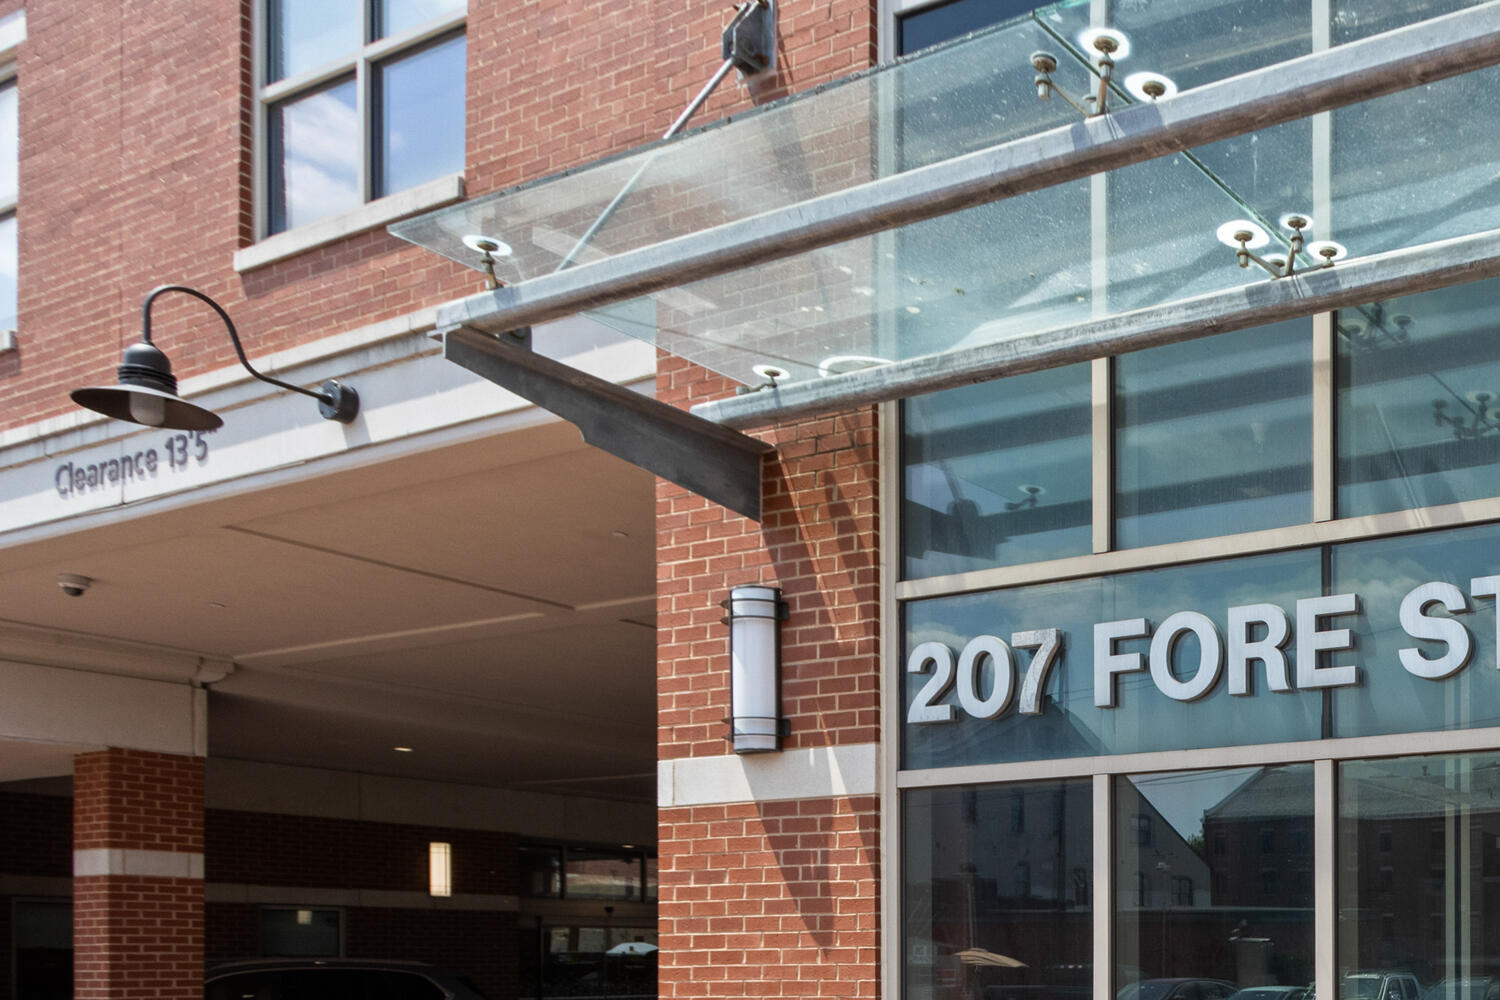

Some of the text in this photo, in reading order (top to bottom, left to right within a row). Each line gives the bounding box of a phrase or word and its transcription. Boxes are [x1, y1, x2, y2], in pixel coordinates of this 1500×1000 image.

[56, 430, 218, 496] Clearance 13'5
[907, 627, 1061, 723] 207
[1093, 592, 1362, 710] FORE
